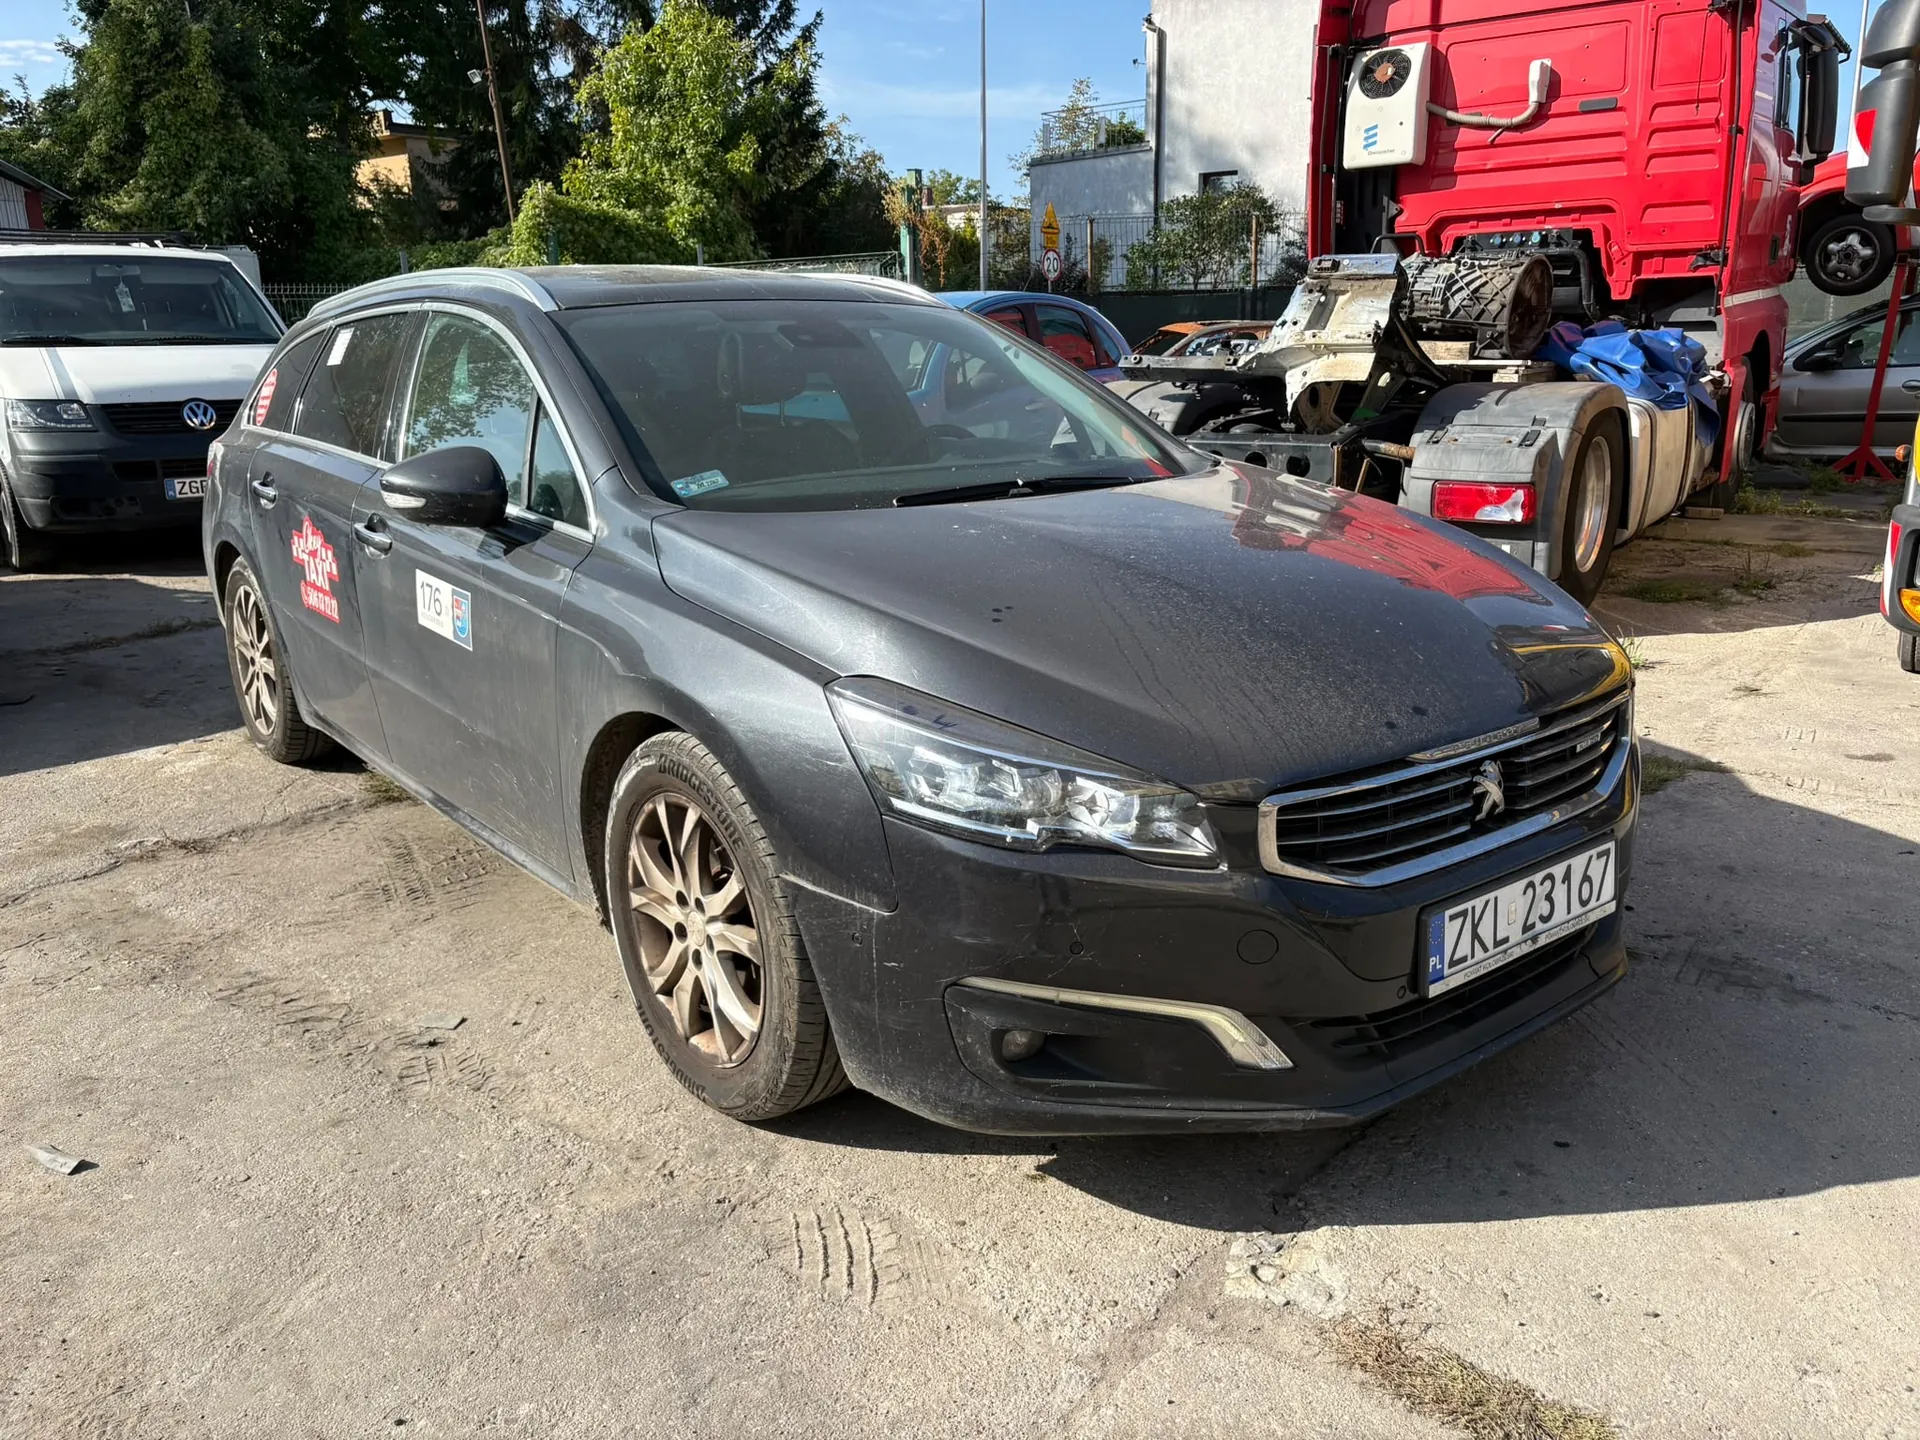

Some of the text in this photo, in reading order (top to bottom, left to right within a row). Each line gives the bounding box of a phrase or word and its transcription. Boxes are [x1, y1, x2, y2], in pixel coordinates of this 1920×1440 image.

[1046, 256, 1059, 273] 20
[303, 552, 331, 592] TAXI
[420, 580, 442, 617] 176
[658, 753, 745, 852] BRIDGESTONE
[1447, 847, 1611, 970] ZKL 23167
[1429, 956, 1442, 972] PL
[636, 999, 707, 1102] BRIDGESTONE
